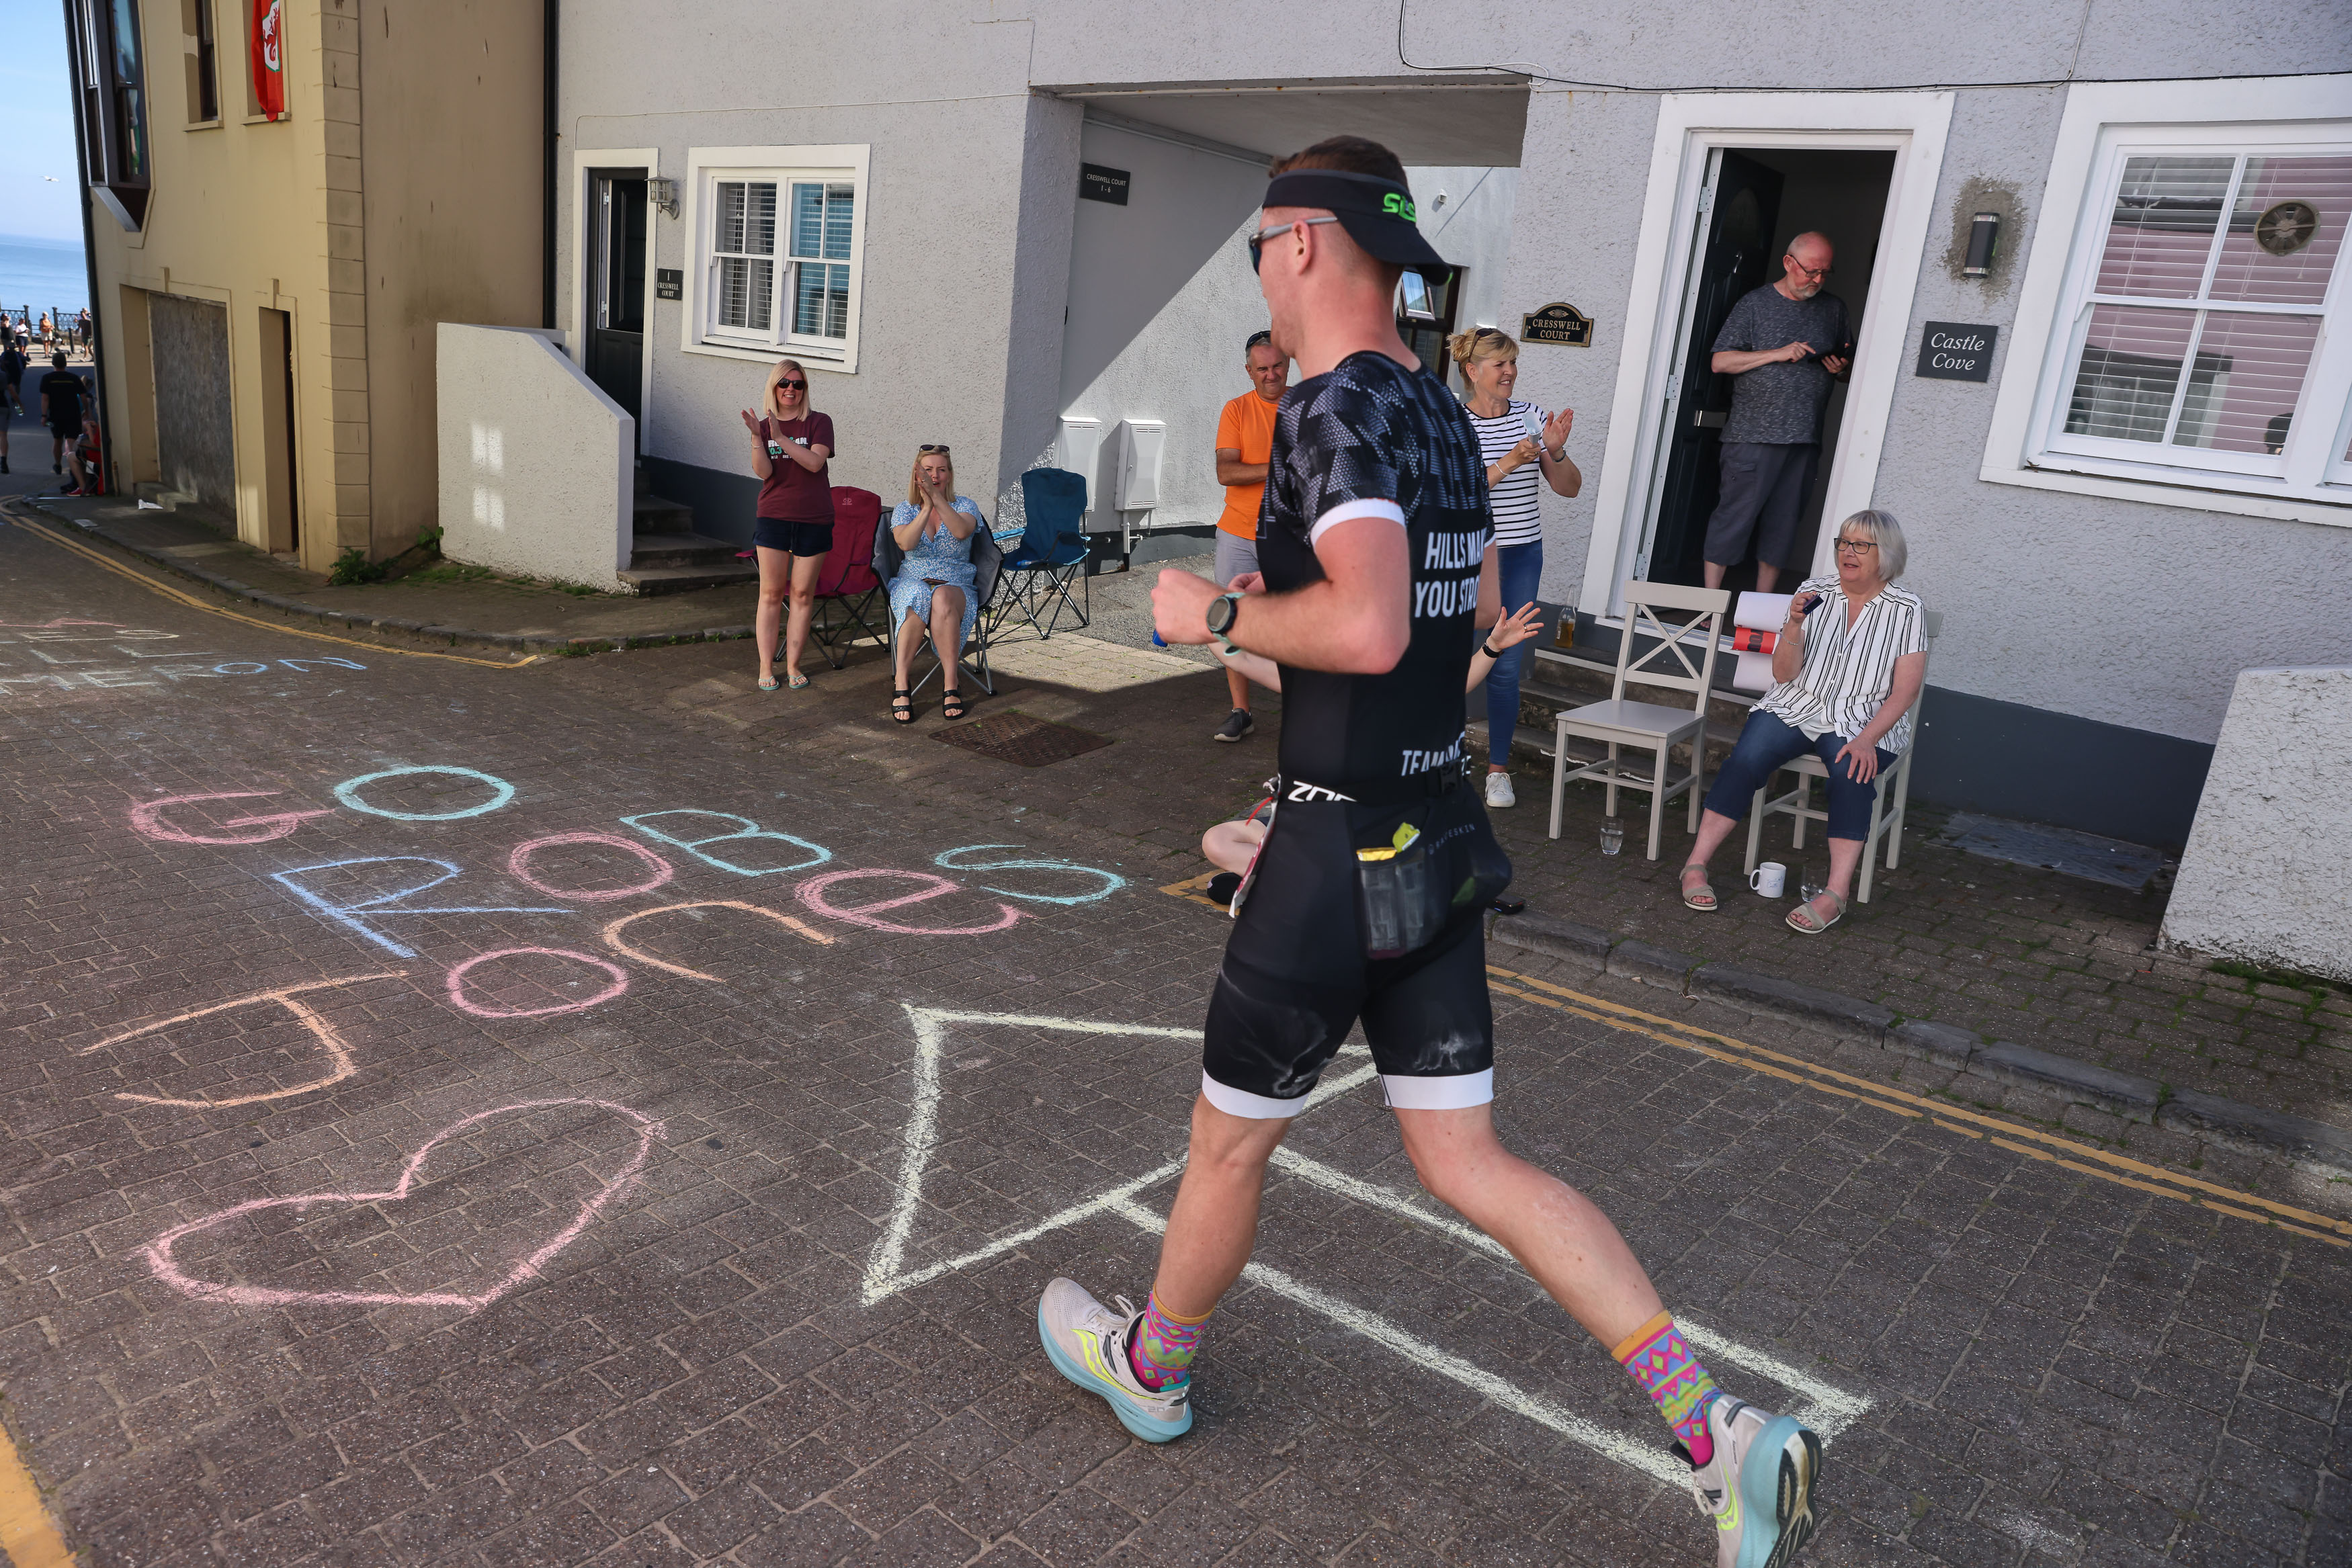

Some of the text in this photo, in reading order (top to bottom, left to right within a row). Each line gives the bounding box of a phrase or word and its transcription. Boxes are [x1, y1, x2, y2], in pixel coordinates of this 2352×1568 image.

[1087, 174, 1126, 187] CRESSWELL COURT
[1532, 318, 1581, 330] CRESSWELL
[1540, 330, 1570, 340] COURT
[1931, 333, 1985, 351] Castle
[1932, 353, 1976, 370] Cove
[769, 447, 782, 455] 0.3
[1425, 531, 1466, 570] HILLS
[1415, 580, 1457, 618] YOU
[129, 765, 517, 846] GO
[270, 809, 832, 959] ROB
